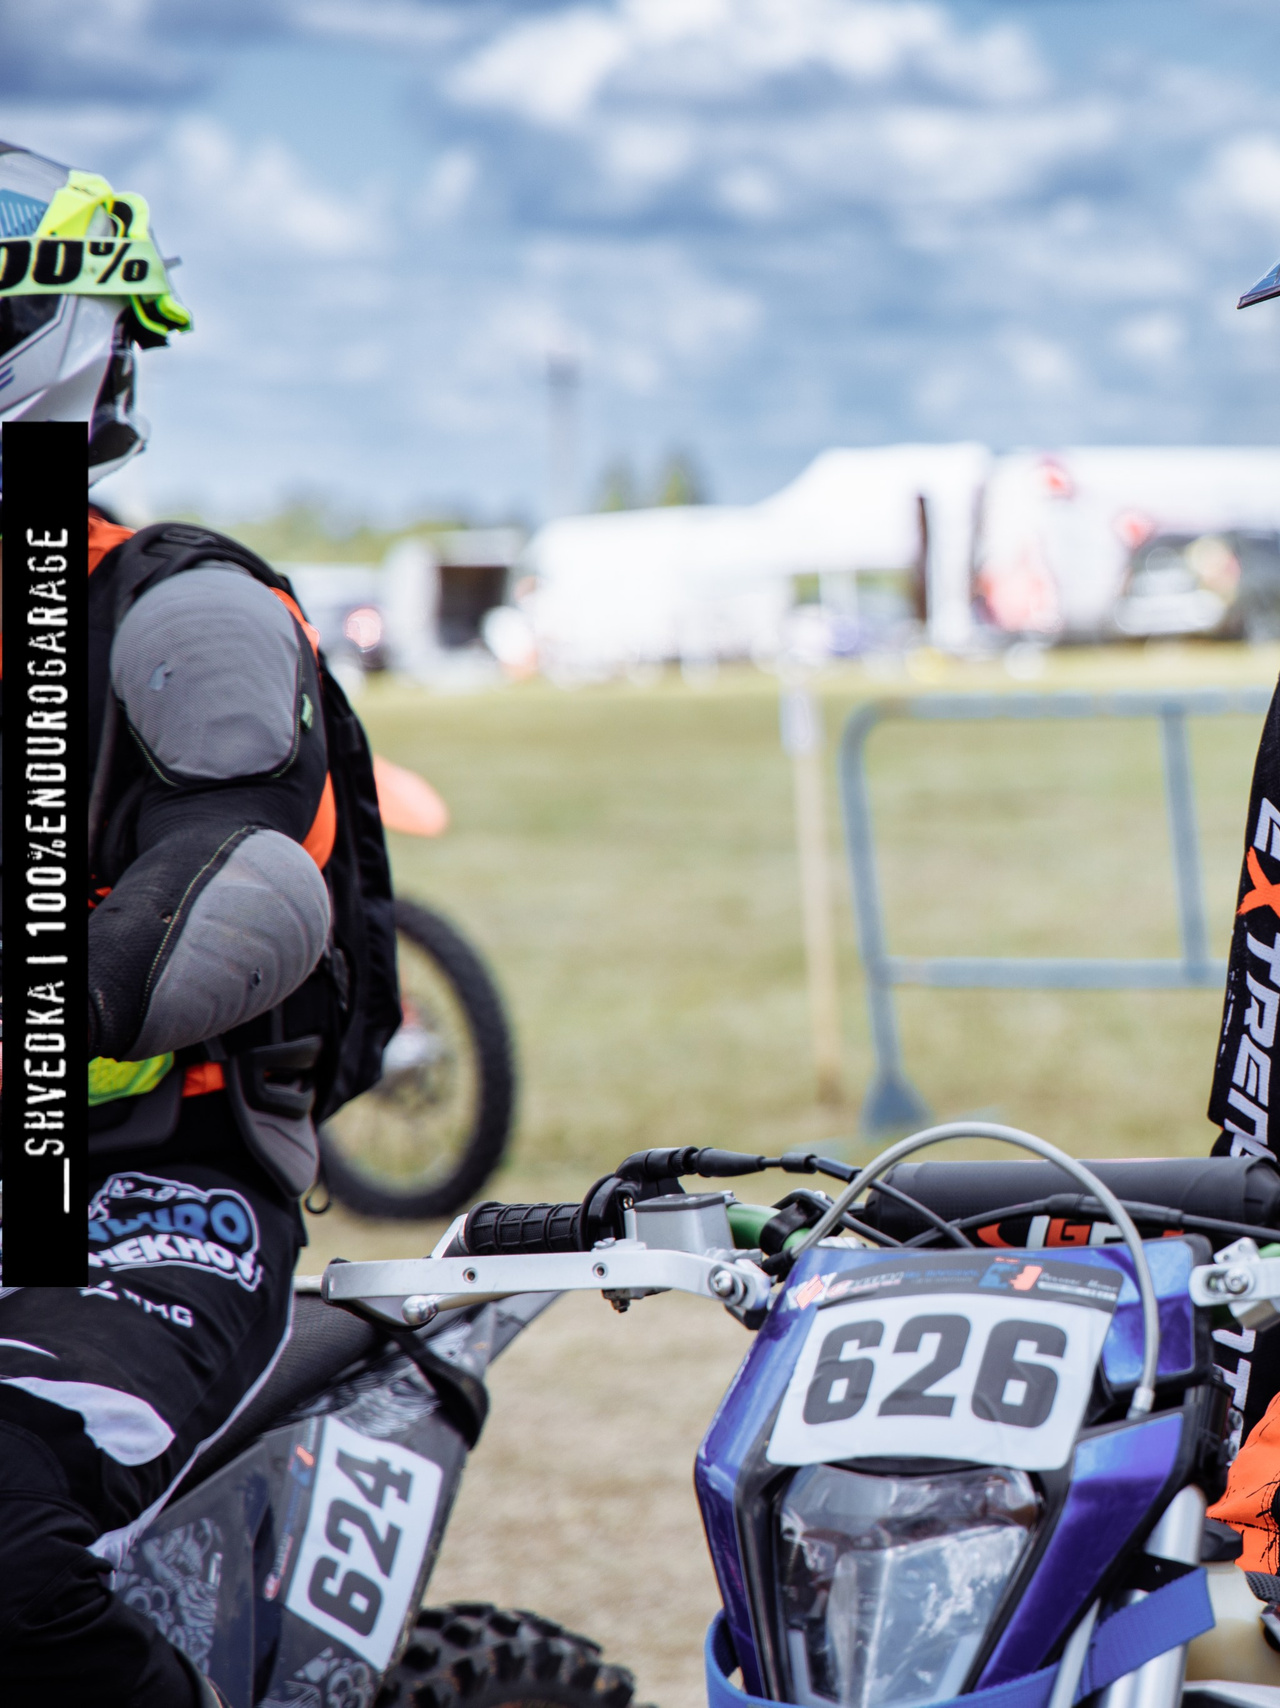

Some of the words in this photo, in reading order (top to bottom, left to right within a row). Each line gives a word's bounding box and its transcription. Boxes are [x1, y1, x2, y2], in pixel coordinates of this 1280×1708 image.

[0, 240, 149, 290] 00%
[802, 1314, 1067, 1428] 626
[307, 1448, 414, 1637] 624
